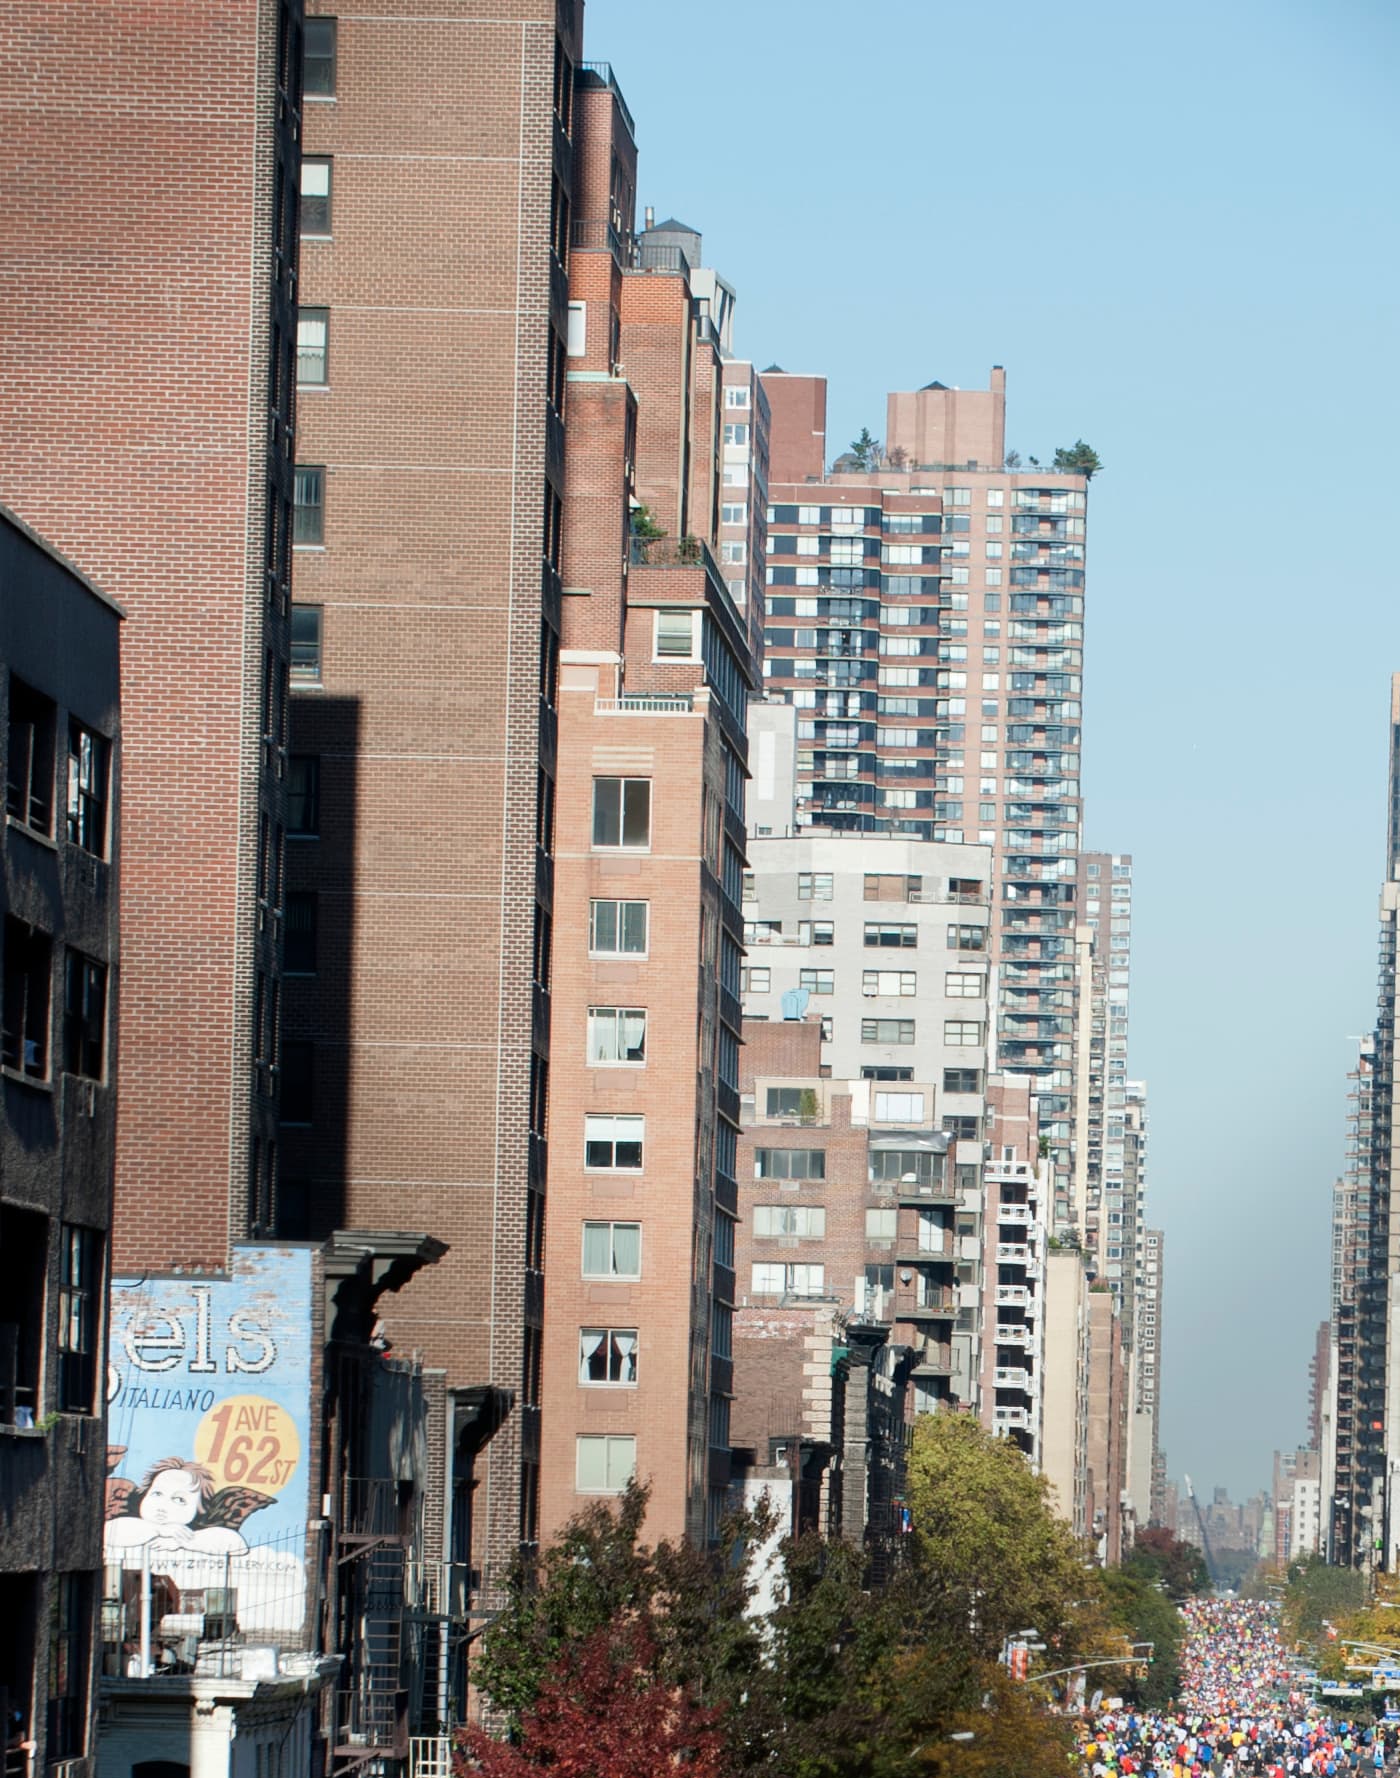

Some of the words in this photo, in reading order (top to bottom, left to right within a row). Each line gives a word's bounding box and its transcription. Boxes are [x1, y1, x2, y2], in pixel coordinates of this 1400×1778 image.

[119, 1386, 215, 1412] ITALIANO
[207, 1405, 234, 1463] 1
[234, 1405, 279, 1432] AVE
